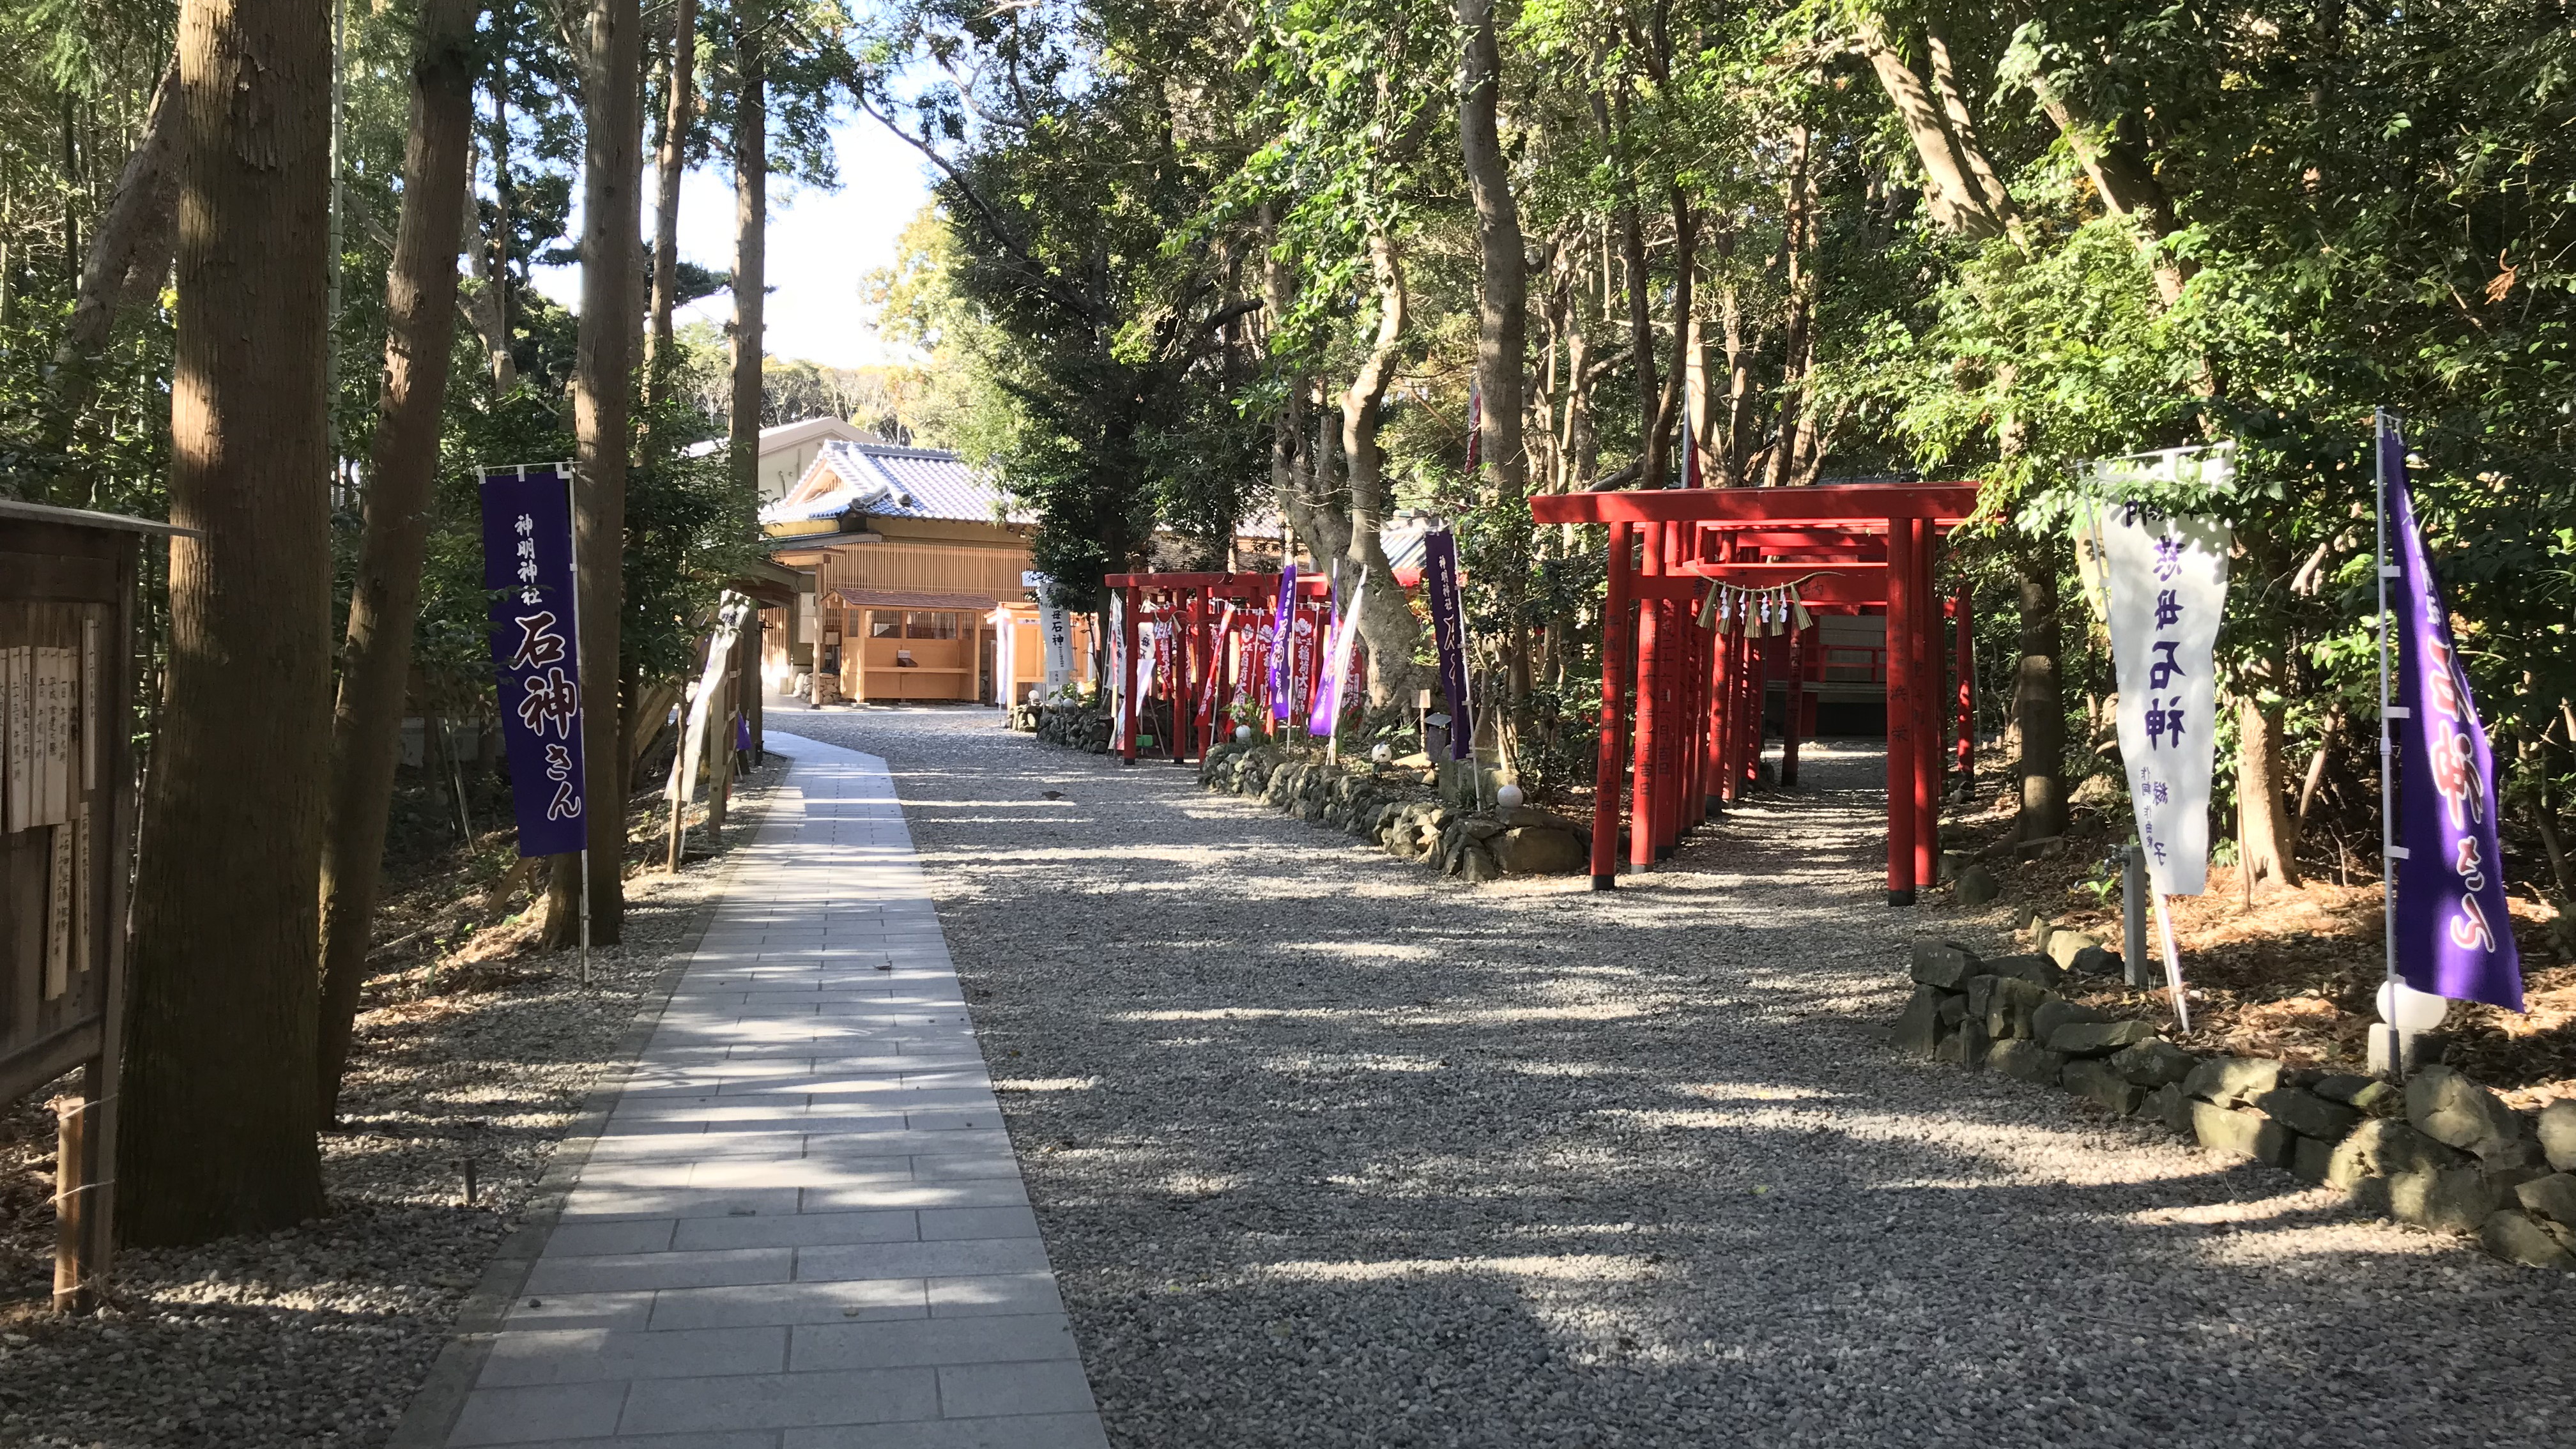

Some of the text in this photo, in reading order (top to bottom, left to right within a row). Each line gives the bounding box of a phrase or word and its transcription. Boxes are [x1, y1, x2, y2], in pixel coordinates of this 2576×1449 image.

[514, 514, 543, 607] 神明神社
[1438, 555, 1453, 611] 神明神社
[509, 610, 582, 822] 石神さん
